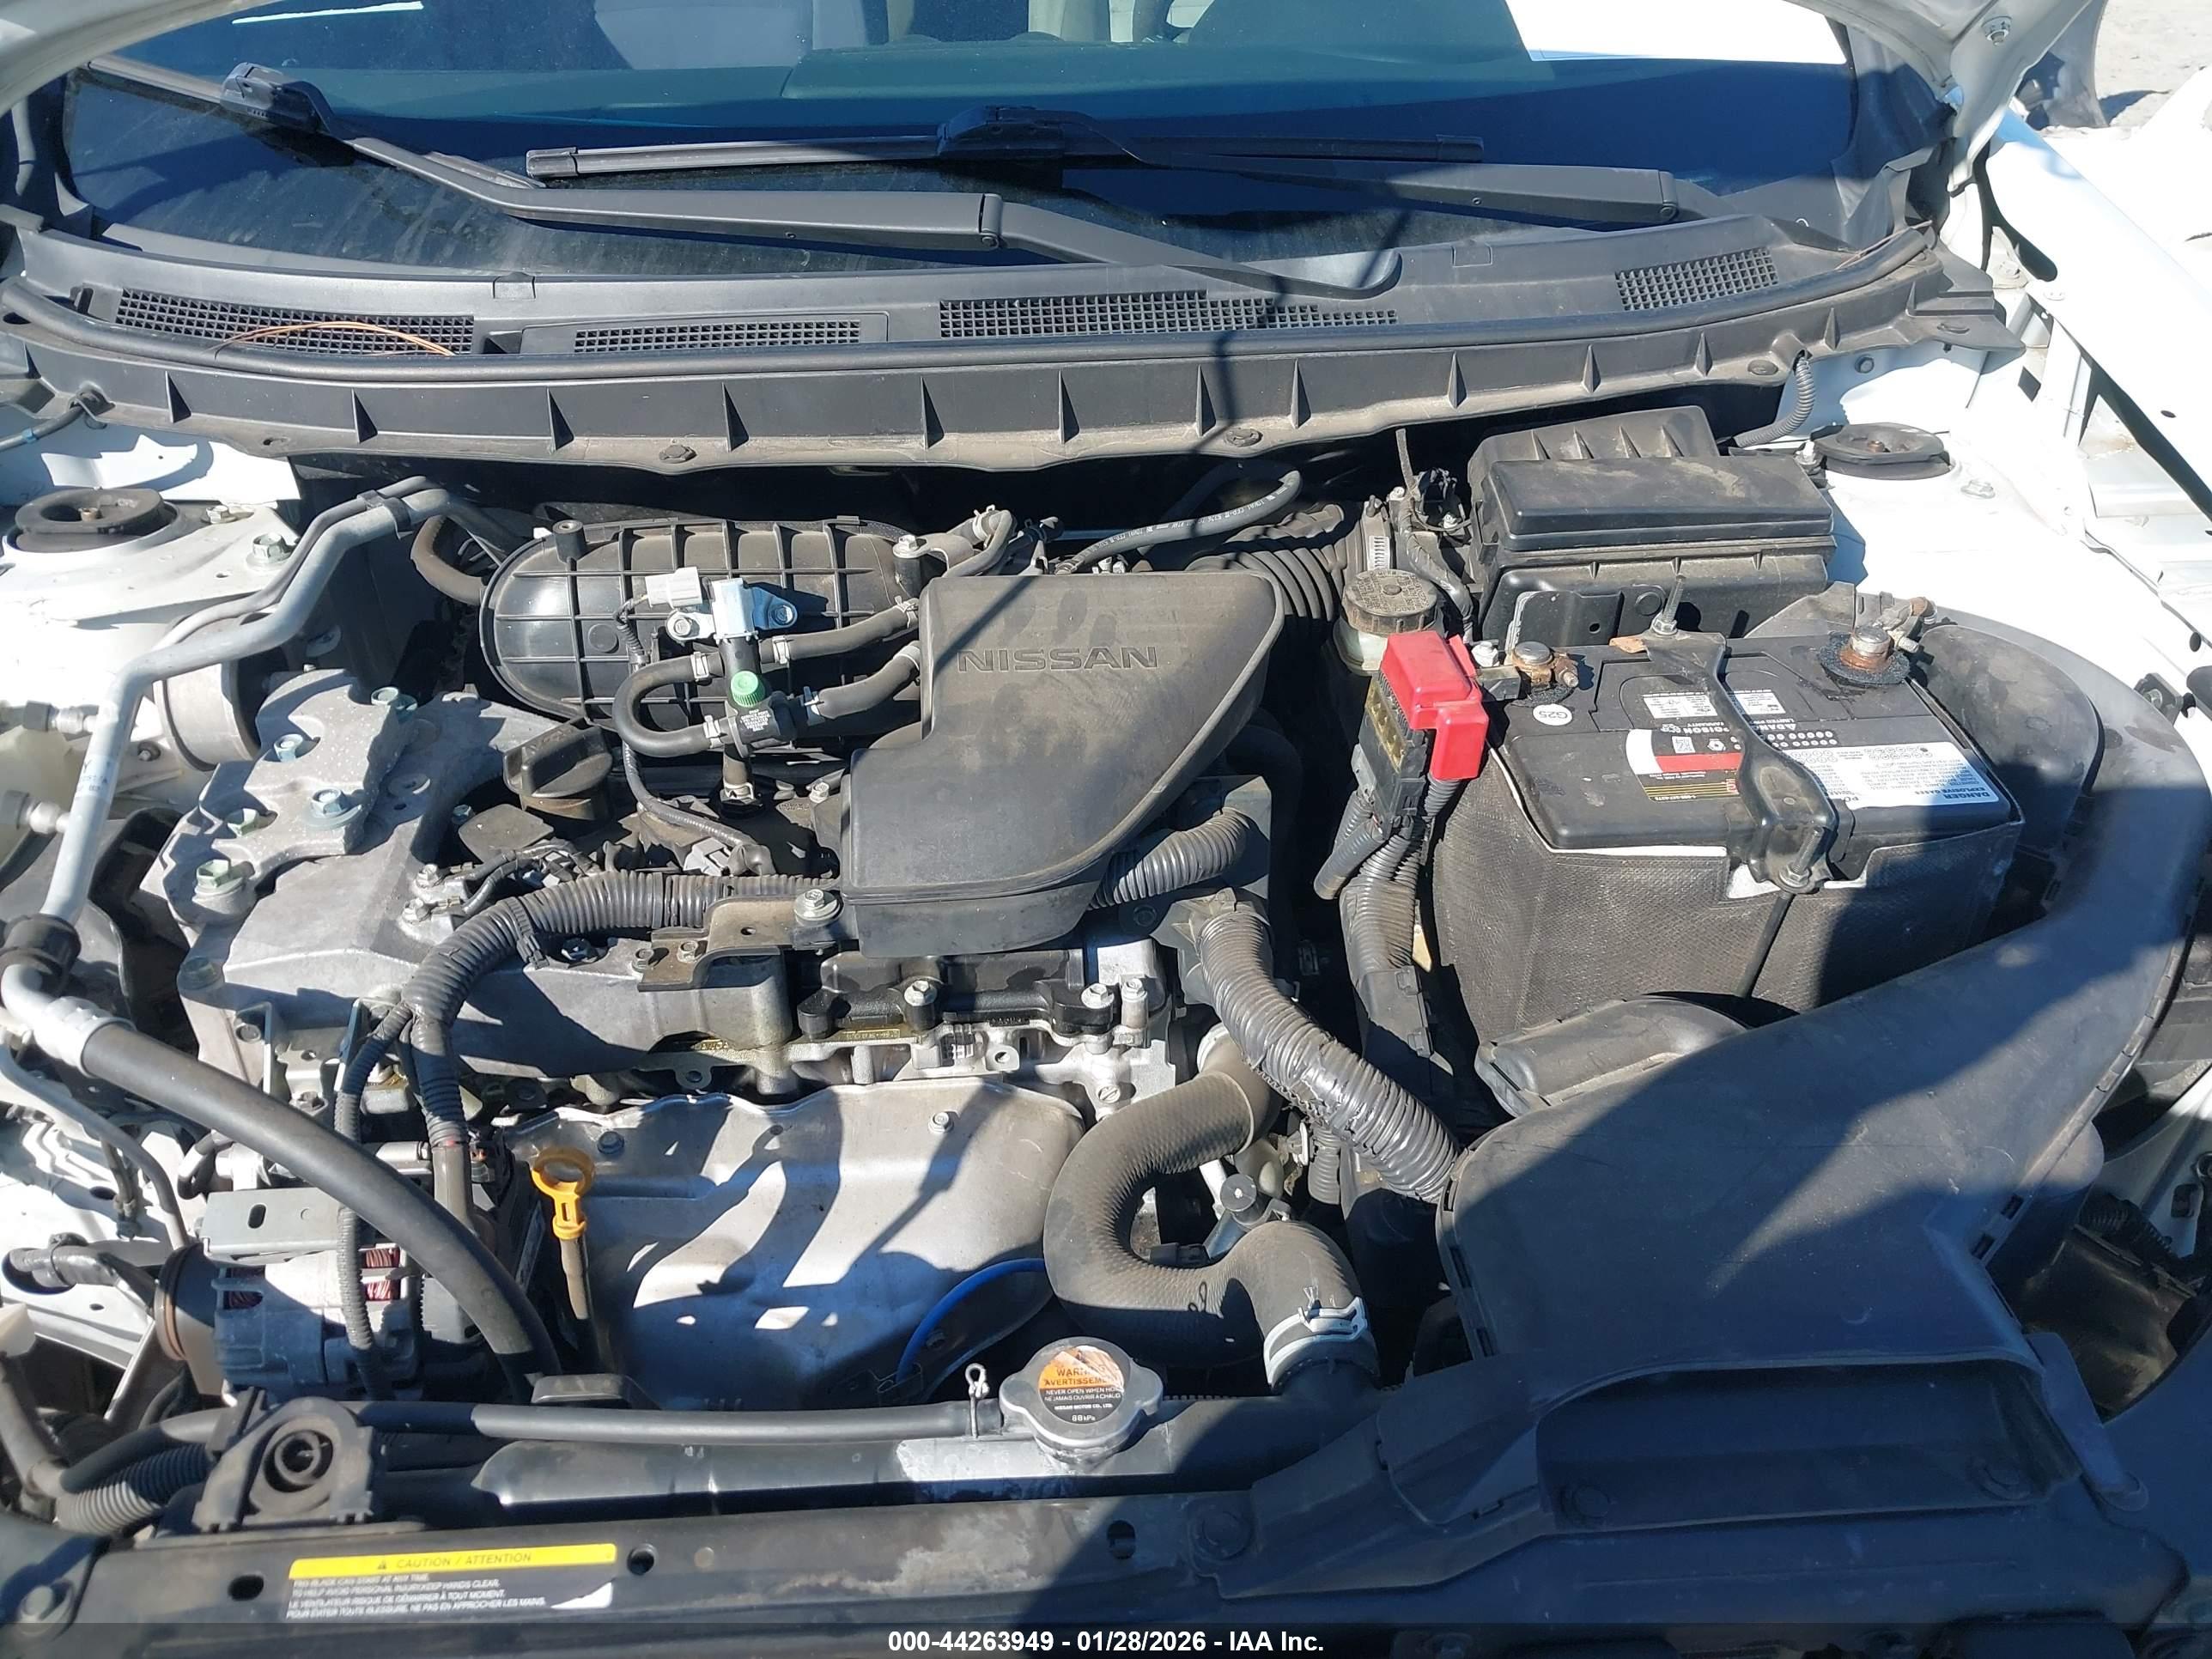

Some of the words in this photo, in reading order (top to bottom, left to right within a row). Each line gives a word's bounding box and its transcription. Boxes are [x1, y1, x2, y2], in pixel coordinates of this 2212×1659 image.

[957, 646, 1158, 672] NISSAN
[1538, 710, 1568, 719] G25
[1943, 791, 1990, 799] DANGER
[397, 1558, 451, 1568] CAUTION
[466, 1553, 532, 1565] ATTENTION
